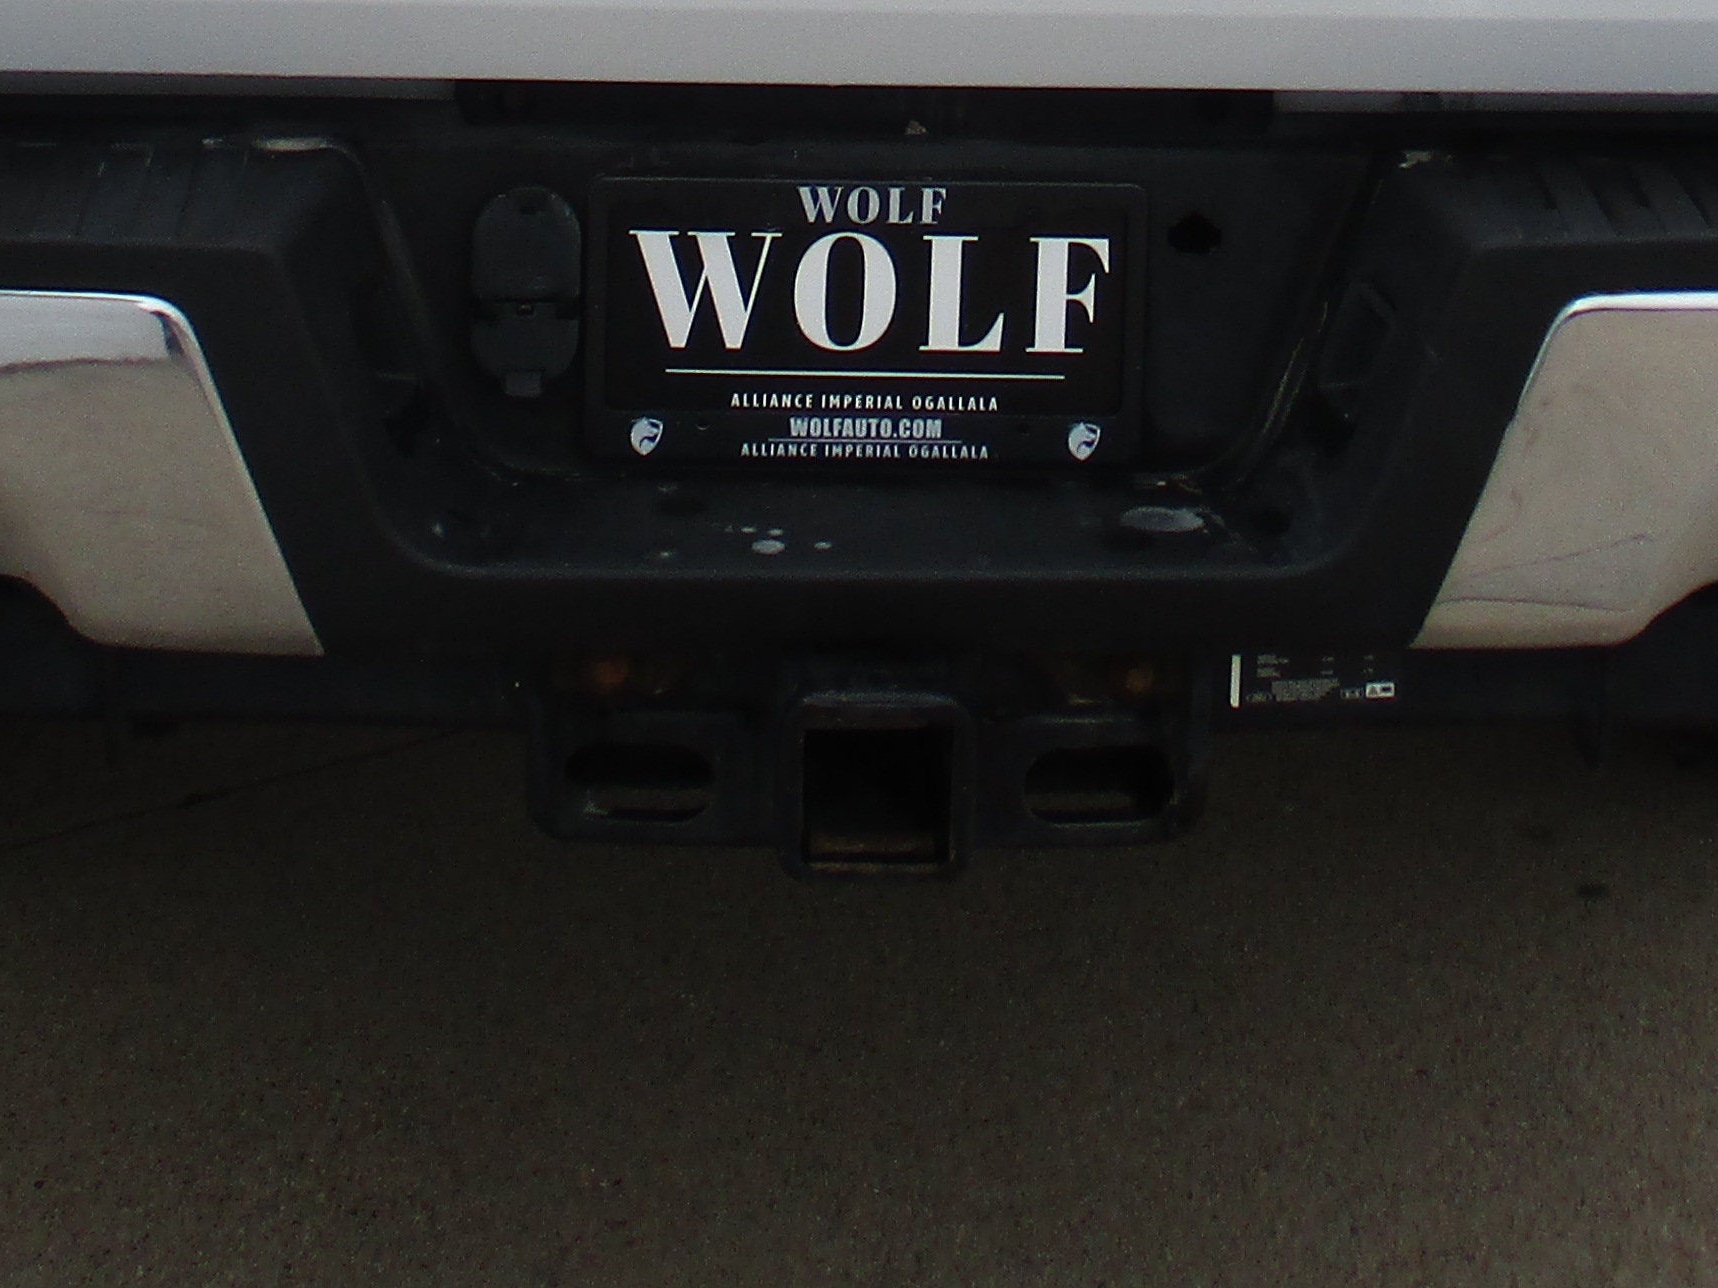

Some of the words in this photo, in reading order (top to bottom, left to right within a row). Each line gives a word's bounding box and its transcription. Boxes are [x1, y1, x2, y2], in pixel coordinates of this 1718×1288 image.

[796, 186, 948, 224] WOLF
[628, 229, 1111, 354] WOLF
[730, 392, 814, 409] ALLIANCE
[821, 394, 904, 411] IMPERIAL
[911, 395, 998, 413] OGALLALA
[789, 416, 943, 439] WOLFAUTO.COM
[740, 442, 818, 458] ALLIANCE
[824, 444, 902, 459] IMPERIAL
[907, 445, 990, 461] OGALLALA
